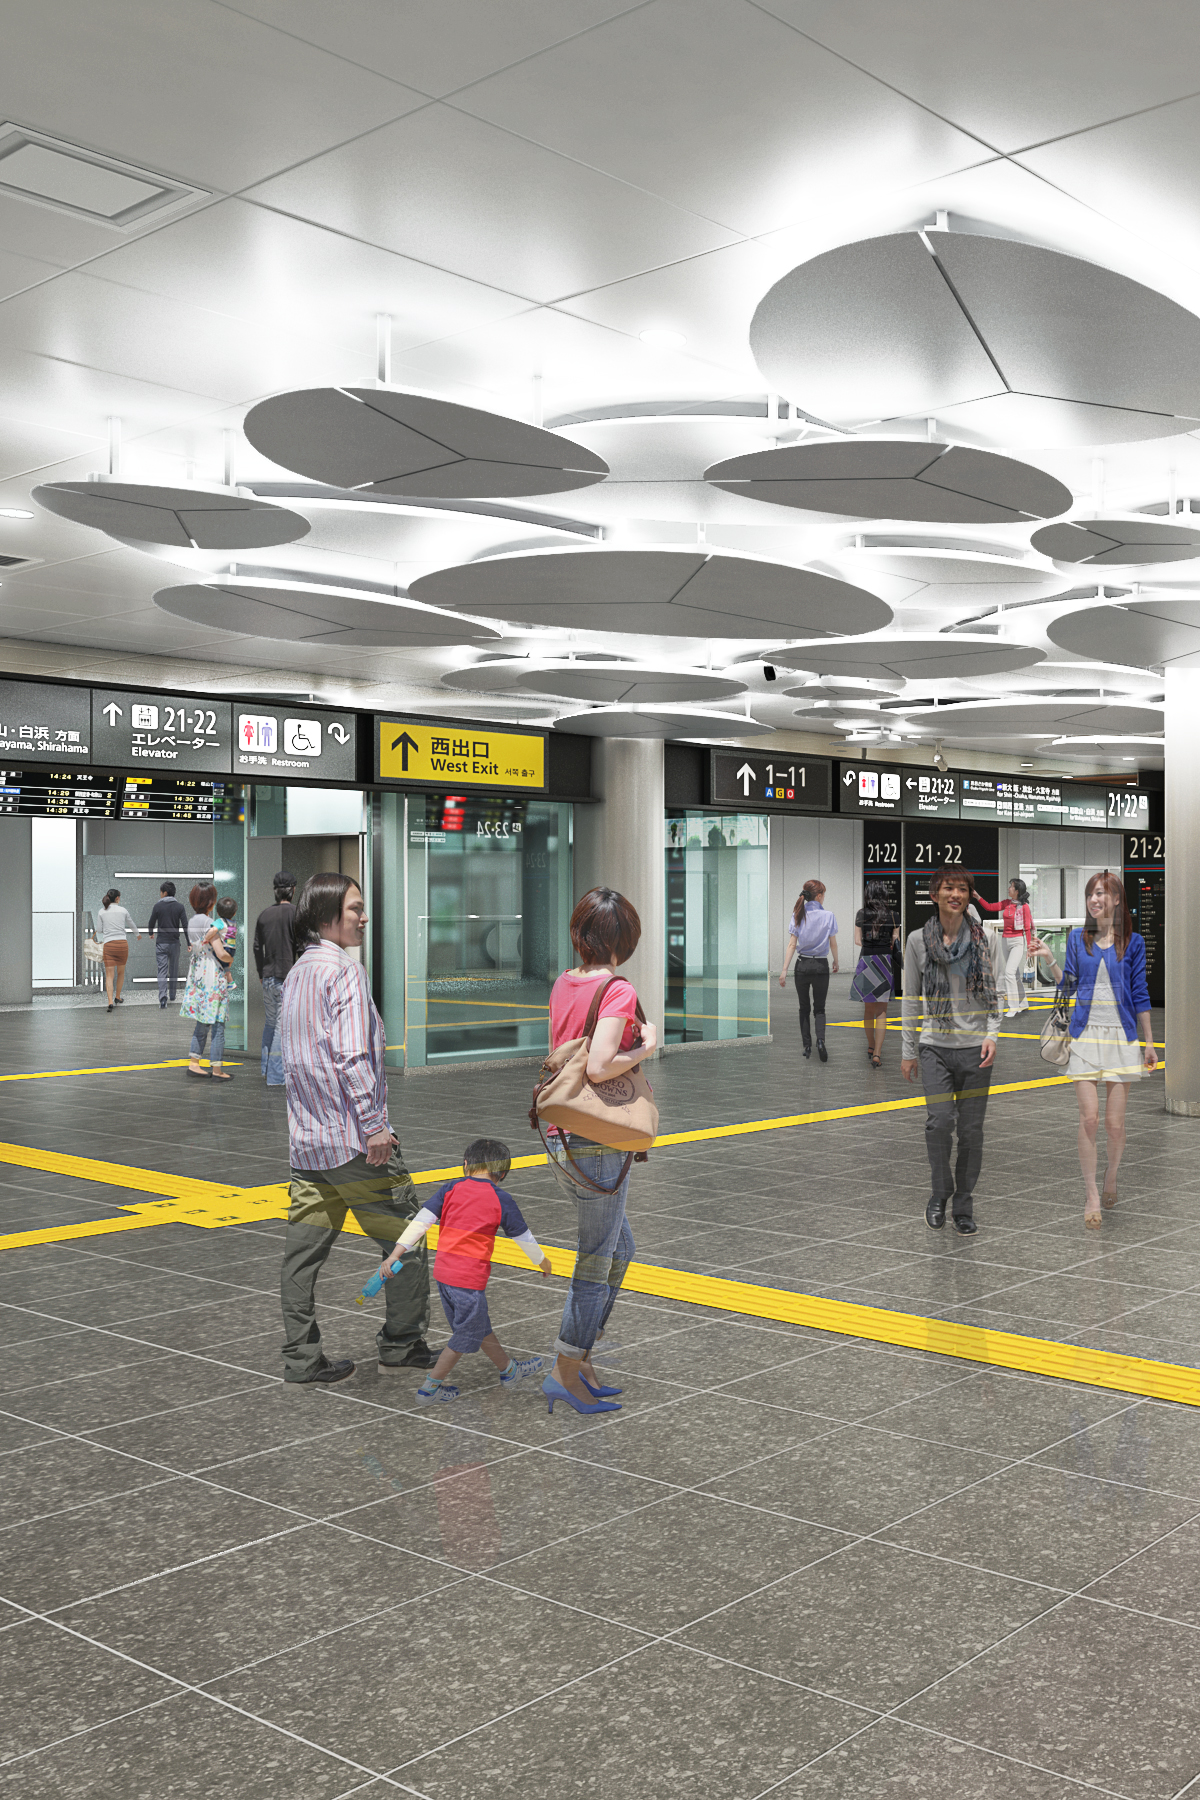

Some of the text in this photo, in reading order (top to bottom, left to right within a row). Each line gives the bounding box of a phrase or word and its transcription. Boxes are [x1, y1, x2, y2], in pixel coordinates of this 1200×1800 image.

[54, 729, 81, 743] 方面
[131, 733, 220, 750] エレベーター
[37, 740, 89, 754] Shirahama
[131, 746, 179, 759] Elevator
[430, 736, 490, 759] 西出口
[238, 754, 310, 768] お手洗 Restroom
[430, 757, 499, 776] West Exit
[504, 767, 535, 778] 서쪽 출구
[766, 788, 794, 799] A G O
[918, 794, 956, 805] エレベーター
[918, 803, 939, 812] Elevator
[1129, 836, 1166, 859] 21·2
